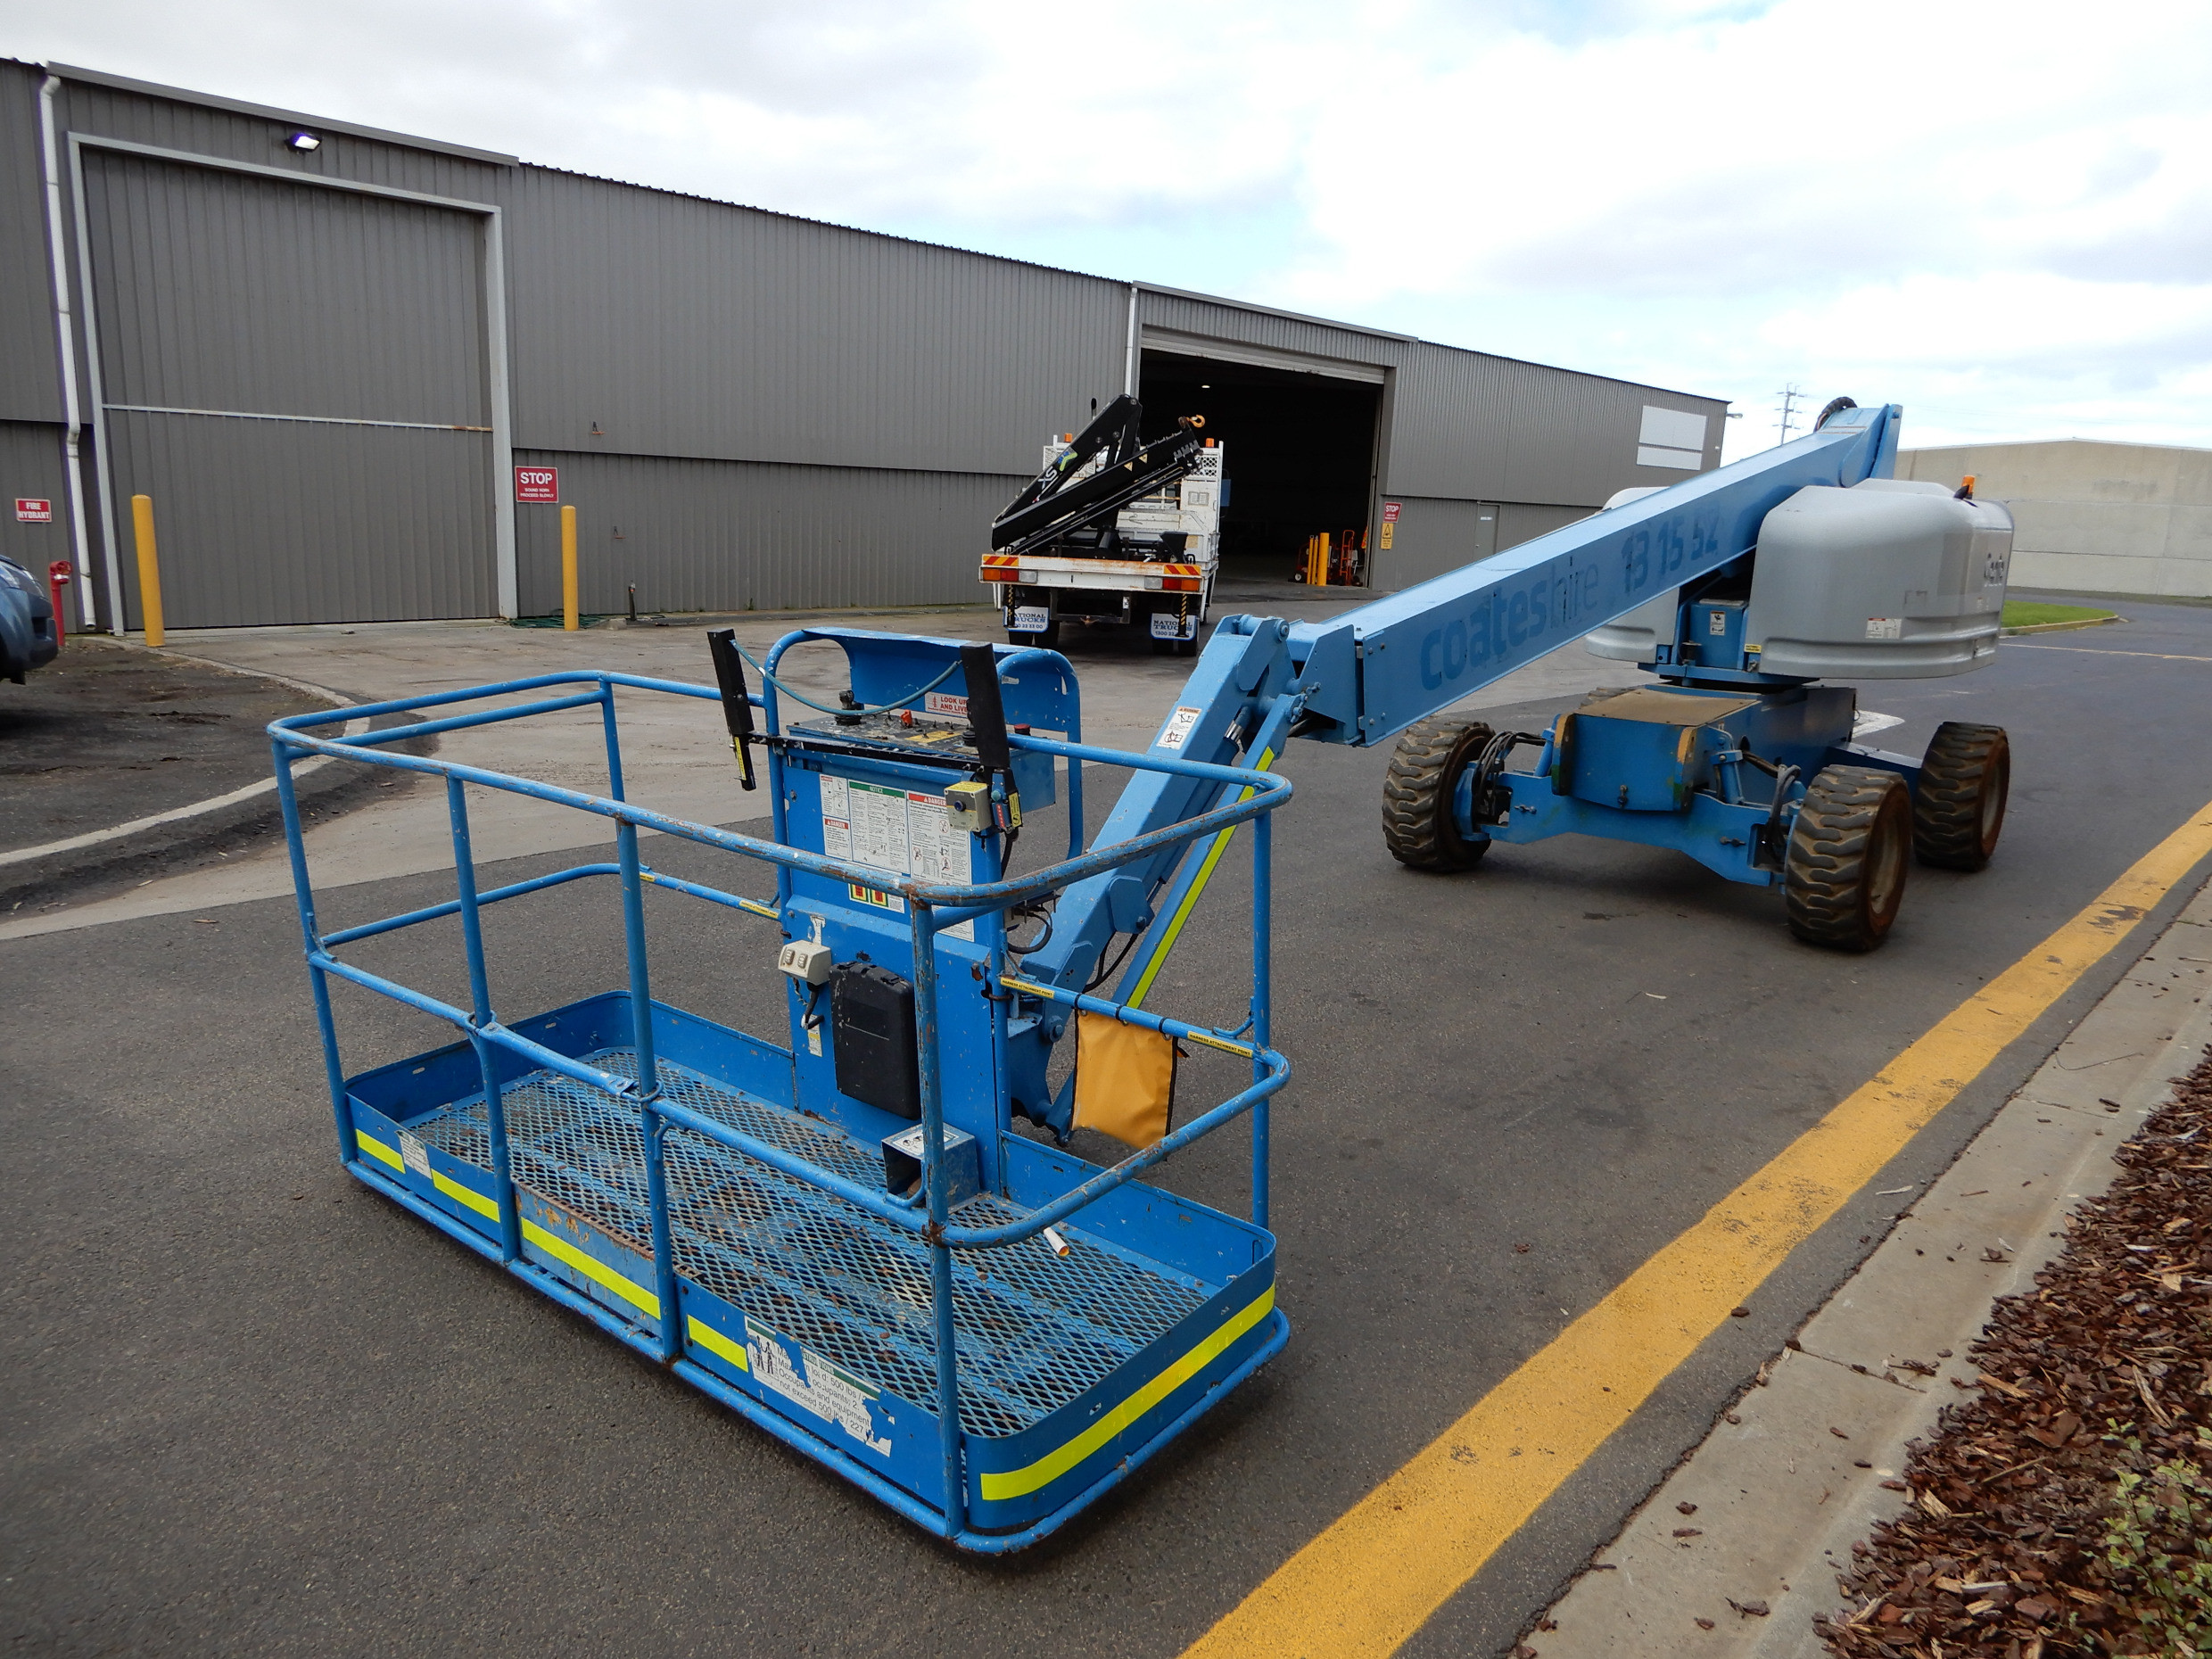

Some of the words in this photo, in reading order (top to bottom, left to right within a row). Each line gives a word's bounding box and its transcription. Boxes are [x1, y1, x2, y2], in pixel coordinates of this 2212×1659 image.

[520, 472, 553, 484] STOP
[26, 501, 42, 510] FIRE
[1385, 505, 1399, 513] STOP
[19, 511, 50, 519] HYDRANT
[1657, 516, 1685, 576] 15
[940, 696, 958, 705] LOOK
[954, 705, 968, 713] LIVE
[869, 785, 884, 795] NOTICE
[928, 796, 947, 806] DANGER
[830, 821, 846, 829] DANGER
[1190, 1034, 1209, 1043] HARNESS
[1209, 1039, 1237, 1051] ATTACHMENT
[1237, 1048, 1250, 1056] POINT
[830, 1377, 845, 1391] 500
[846, 1385, 857, 1399] lbs
[780, 1381, 790, 1392] not
[792, 1388, 817, 1407] exceed
[818, 1402, 832, 1416] 500
[850, 1420, 864, 1433] 227
[816, 1391, 830, 1404] and
[831, 1400, 871, 1427] equipment
